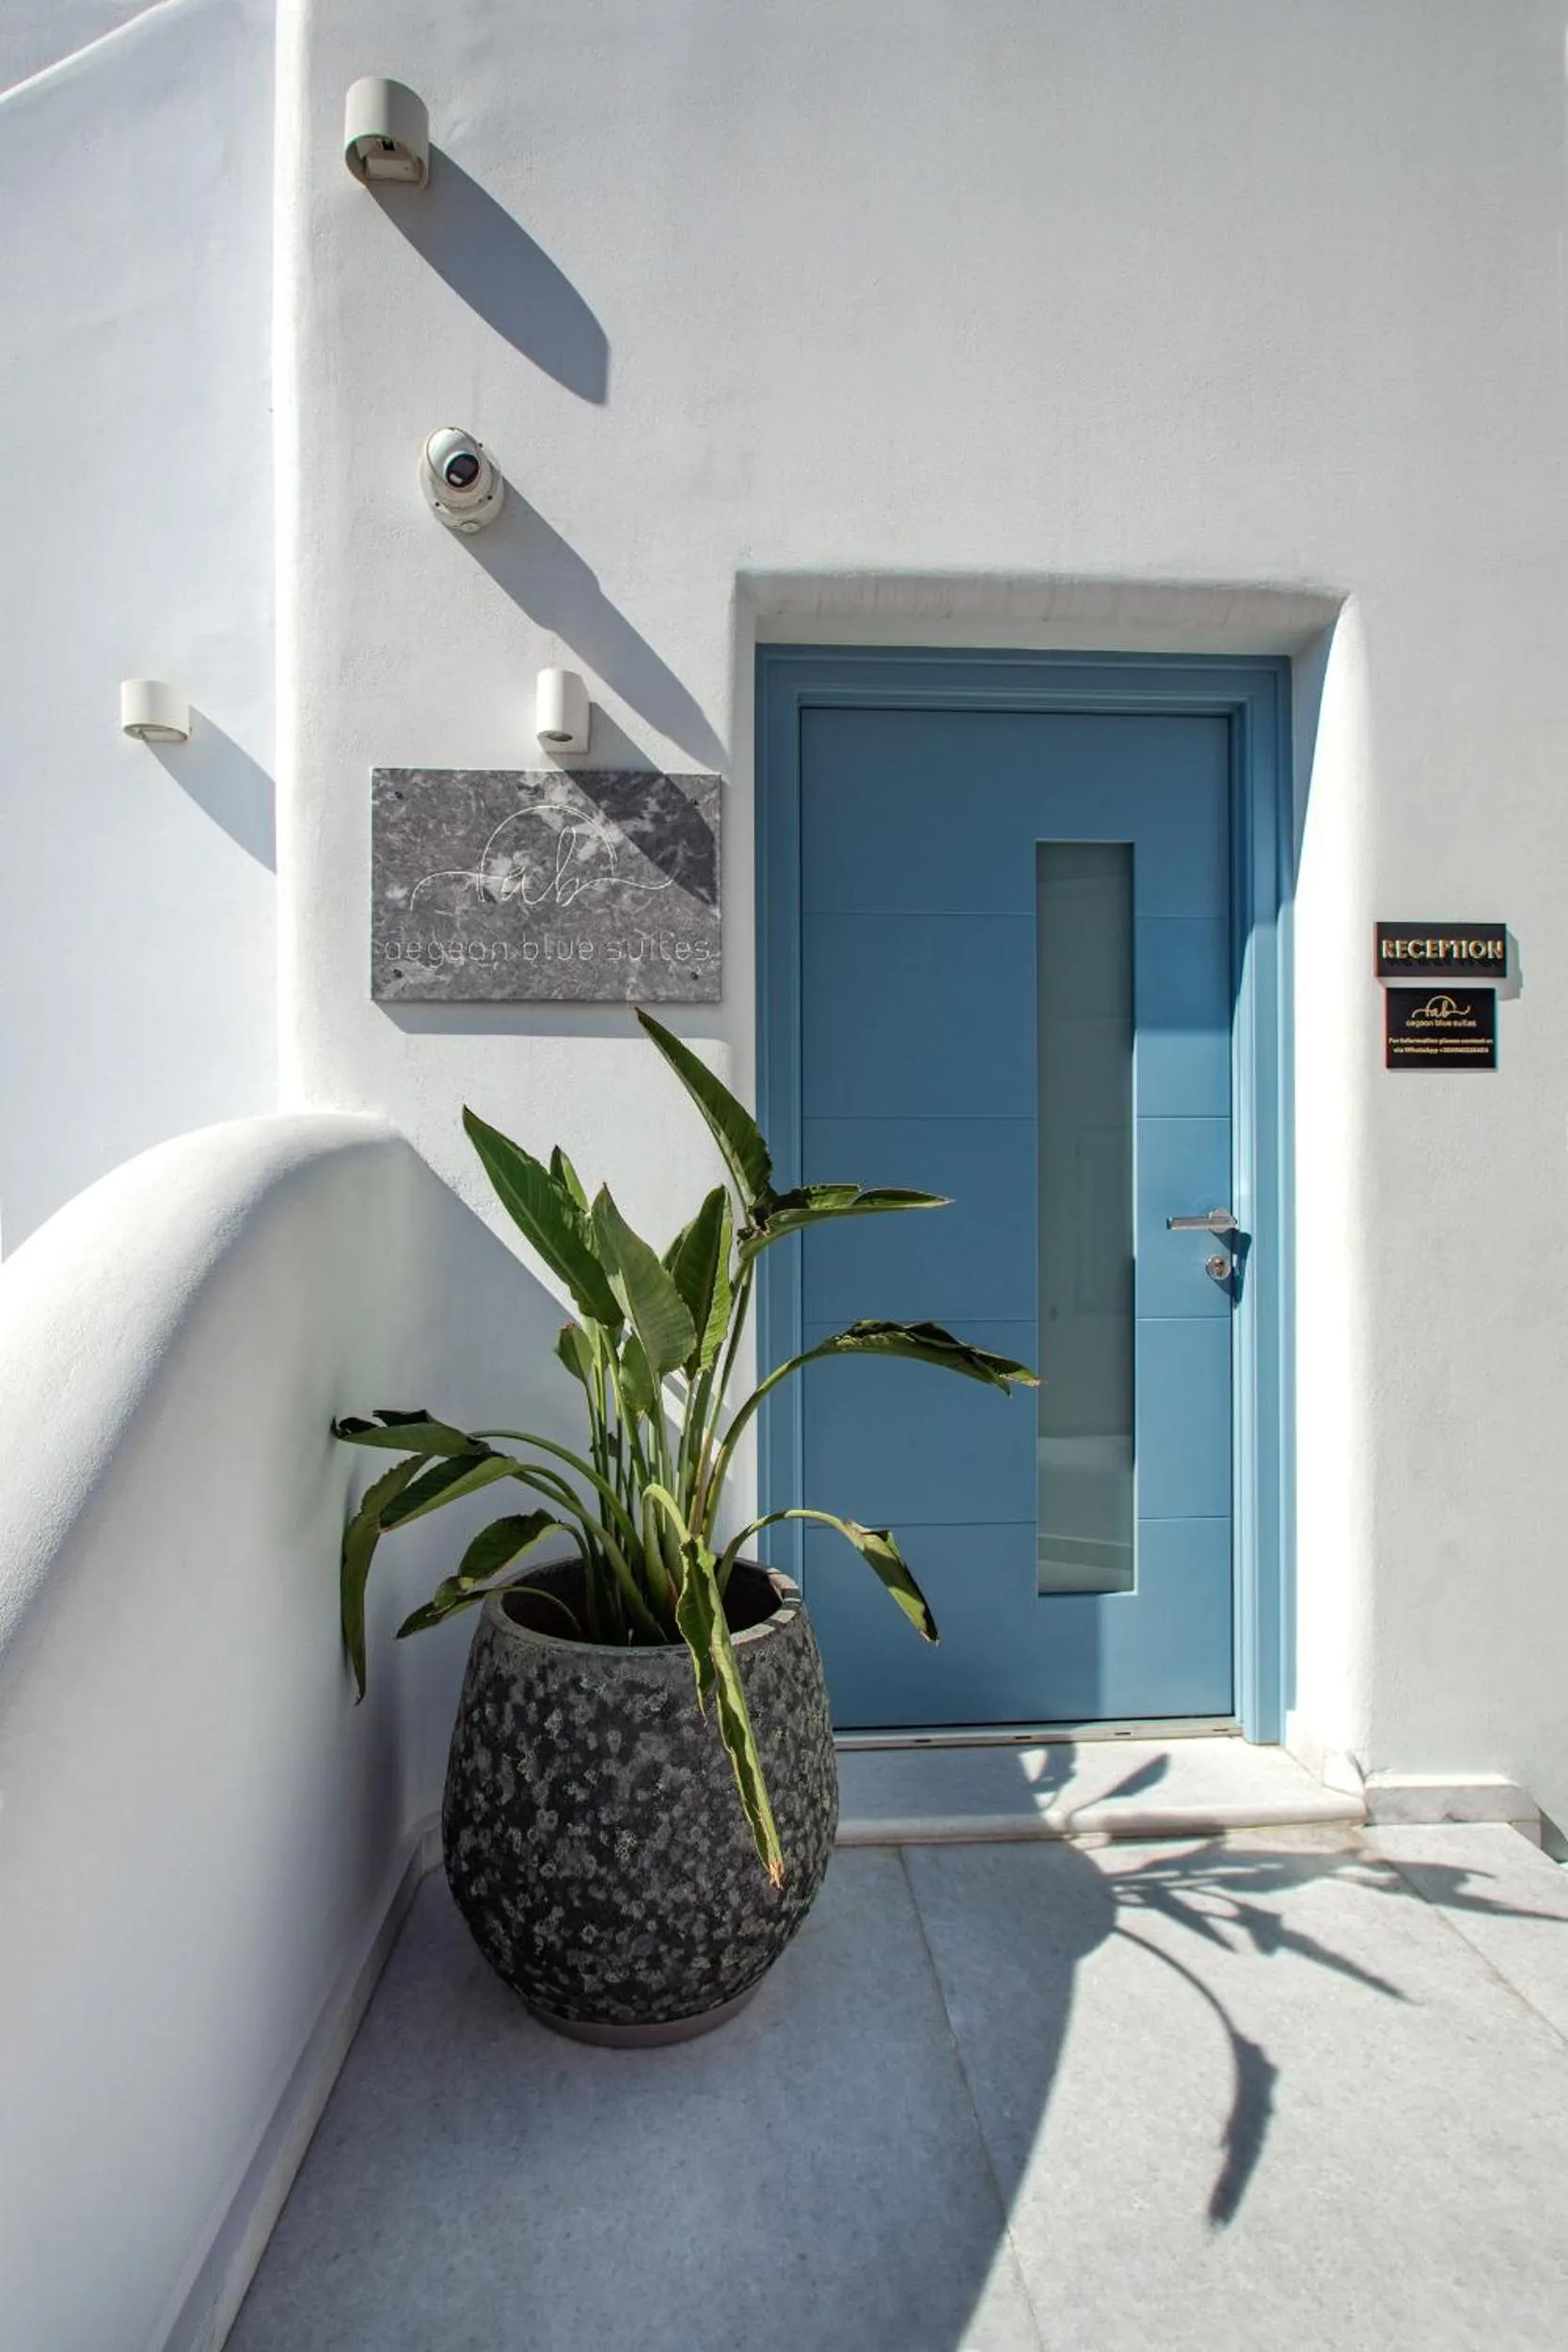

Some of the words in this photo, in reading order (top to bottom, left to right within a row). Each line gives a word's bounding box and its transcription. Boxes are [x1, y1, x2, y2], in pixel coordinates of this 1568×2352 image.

[384, 940, 508, 969] aegean
[523, 931, 594, 961] blue
[606, 930, 709, 961] suites
[1382, 939, 1504, 960] RECEPTION
